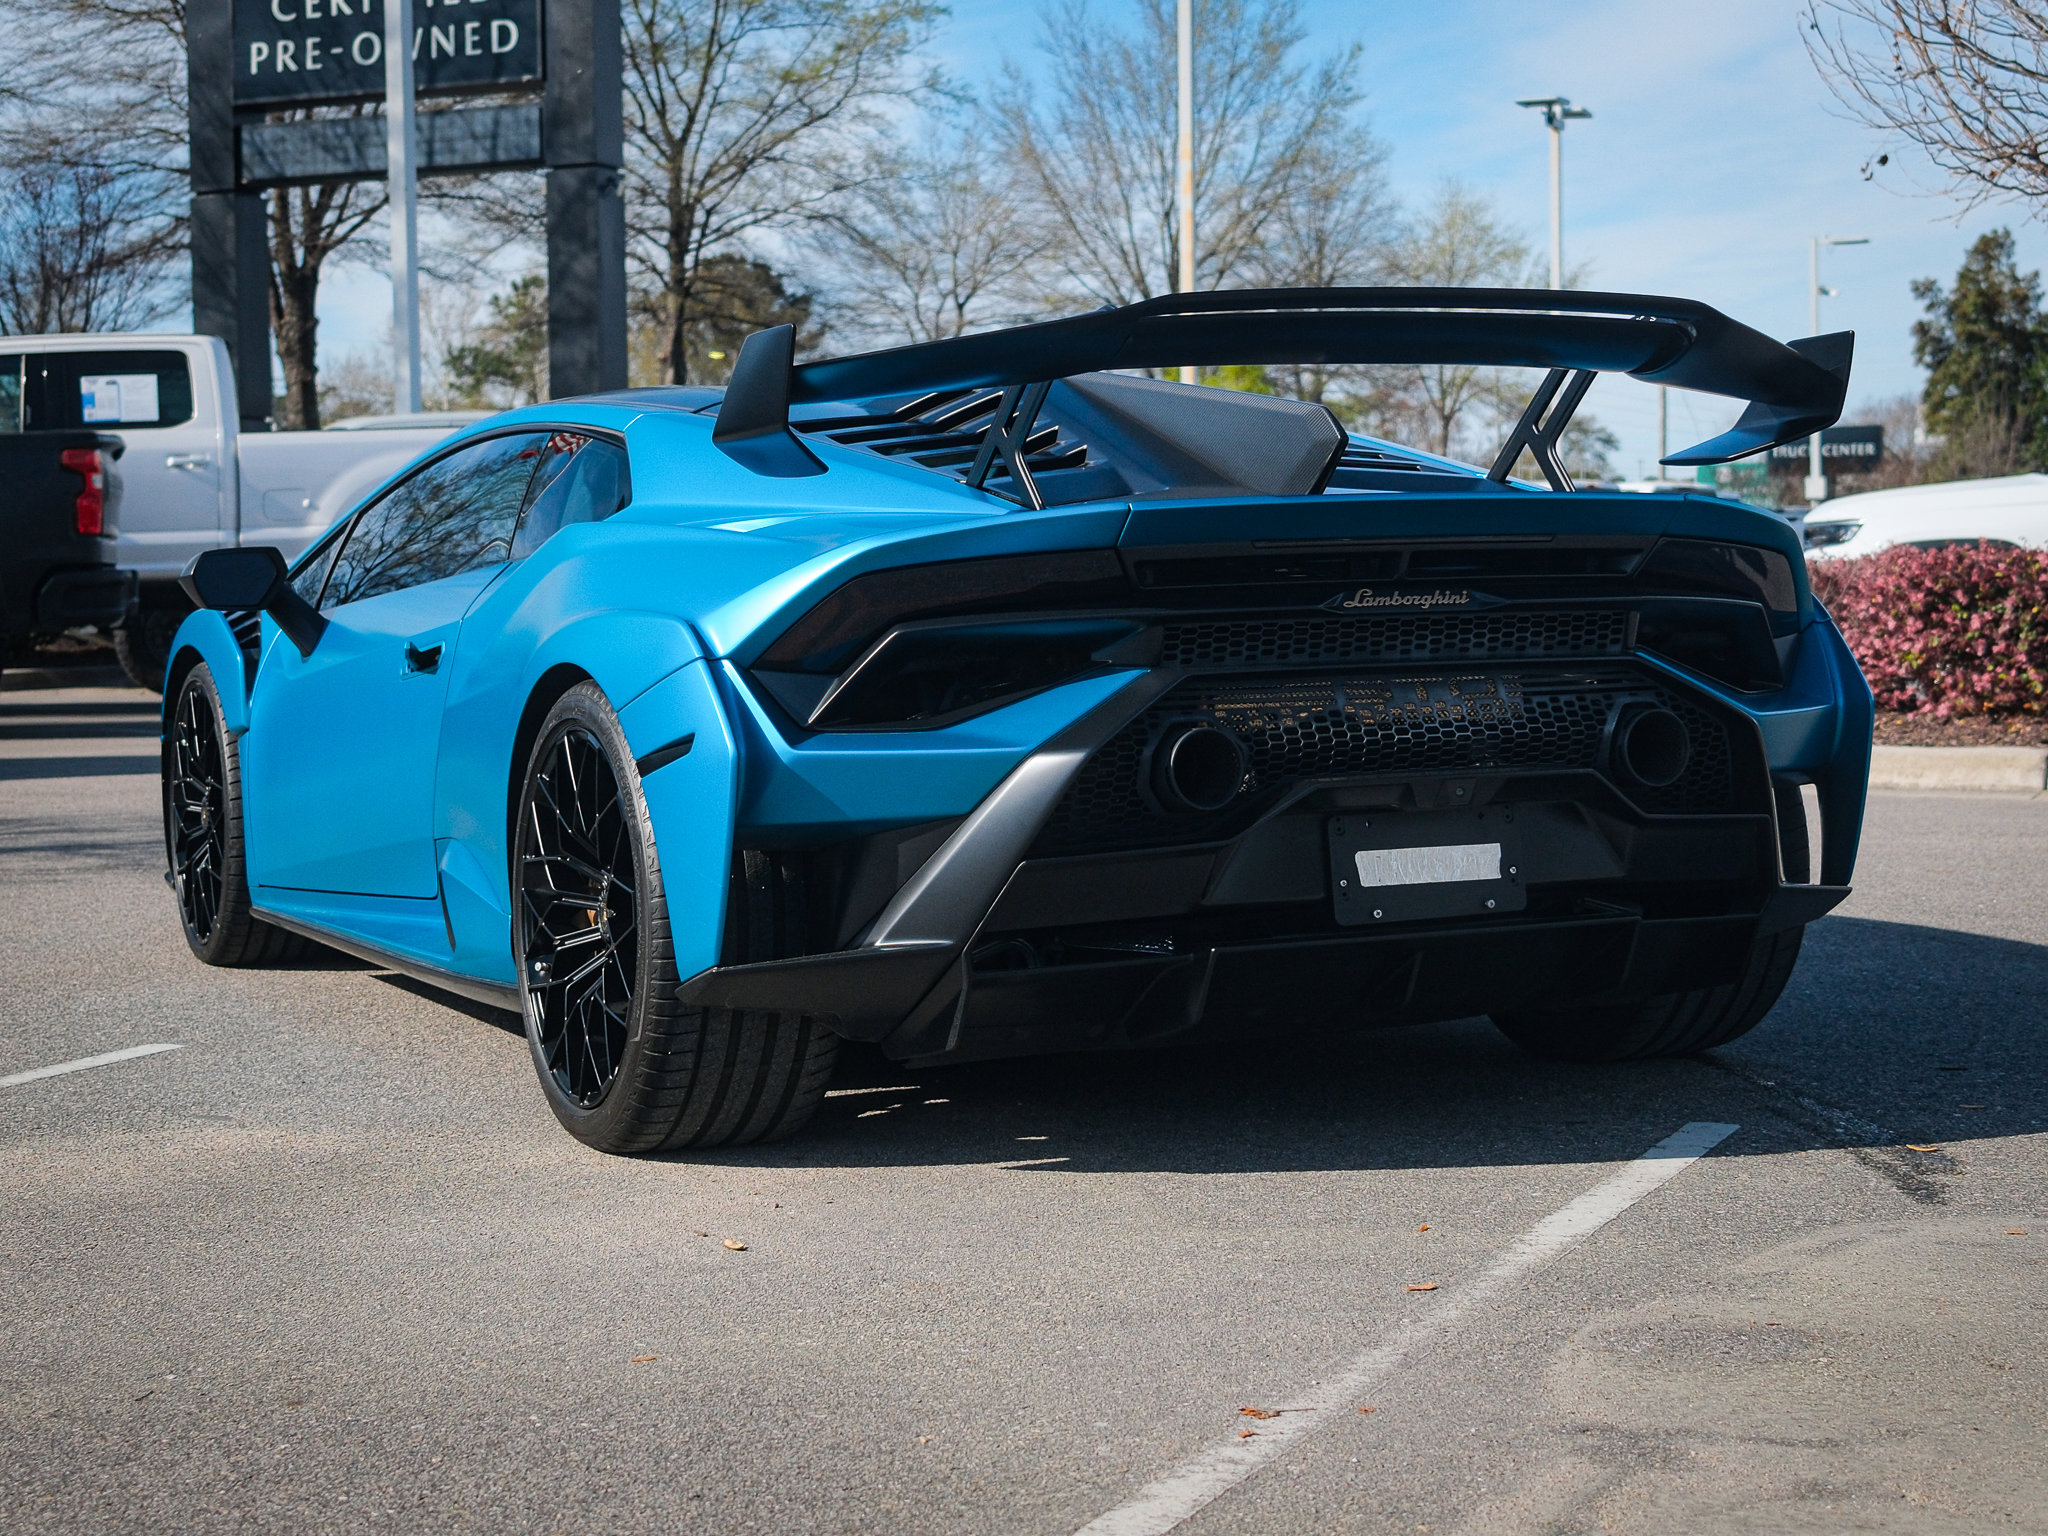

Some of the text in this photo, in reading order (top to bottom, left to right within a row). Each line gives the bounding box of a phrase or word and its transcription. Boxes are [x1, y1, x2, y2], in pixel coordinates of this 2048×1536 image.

[250, 19, 520, 75] PRE-ONED
[1772, 442, 1876, 458] TRUC CENTER
[1343, 588, 1470, 609] Lamborghini
